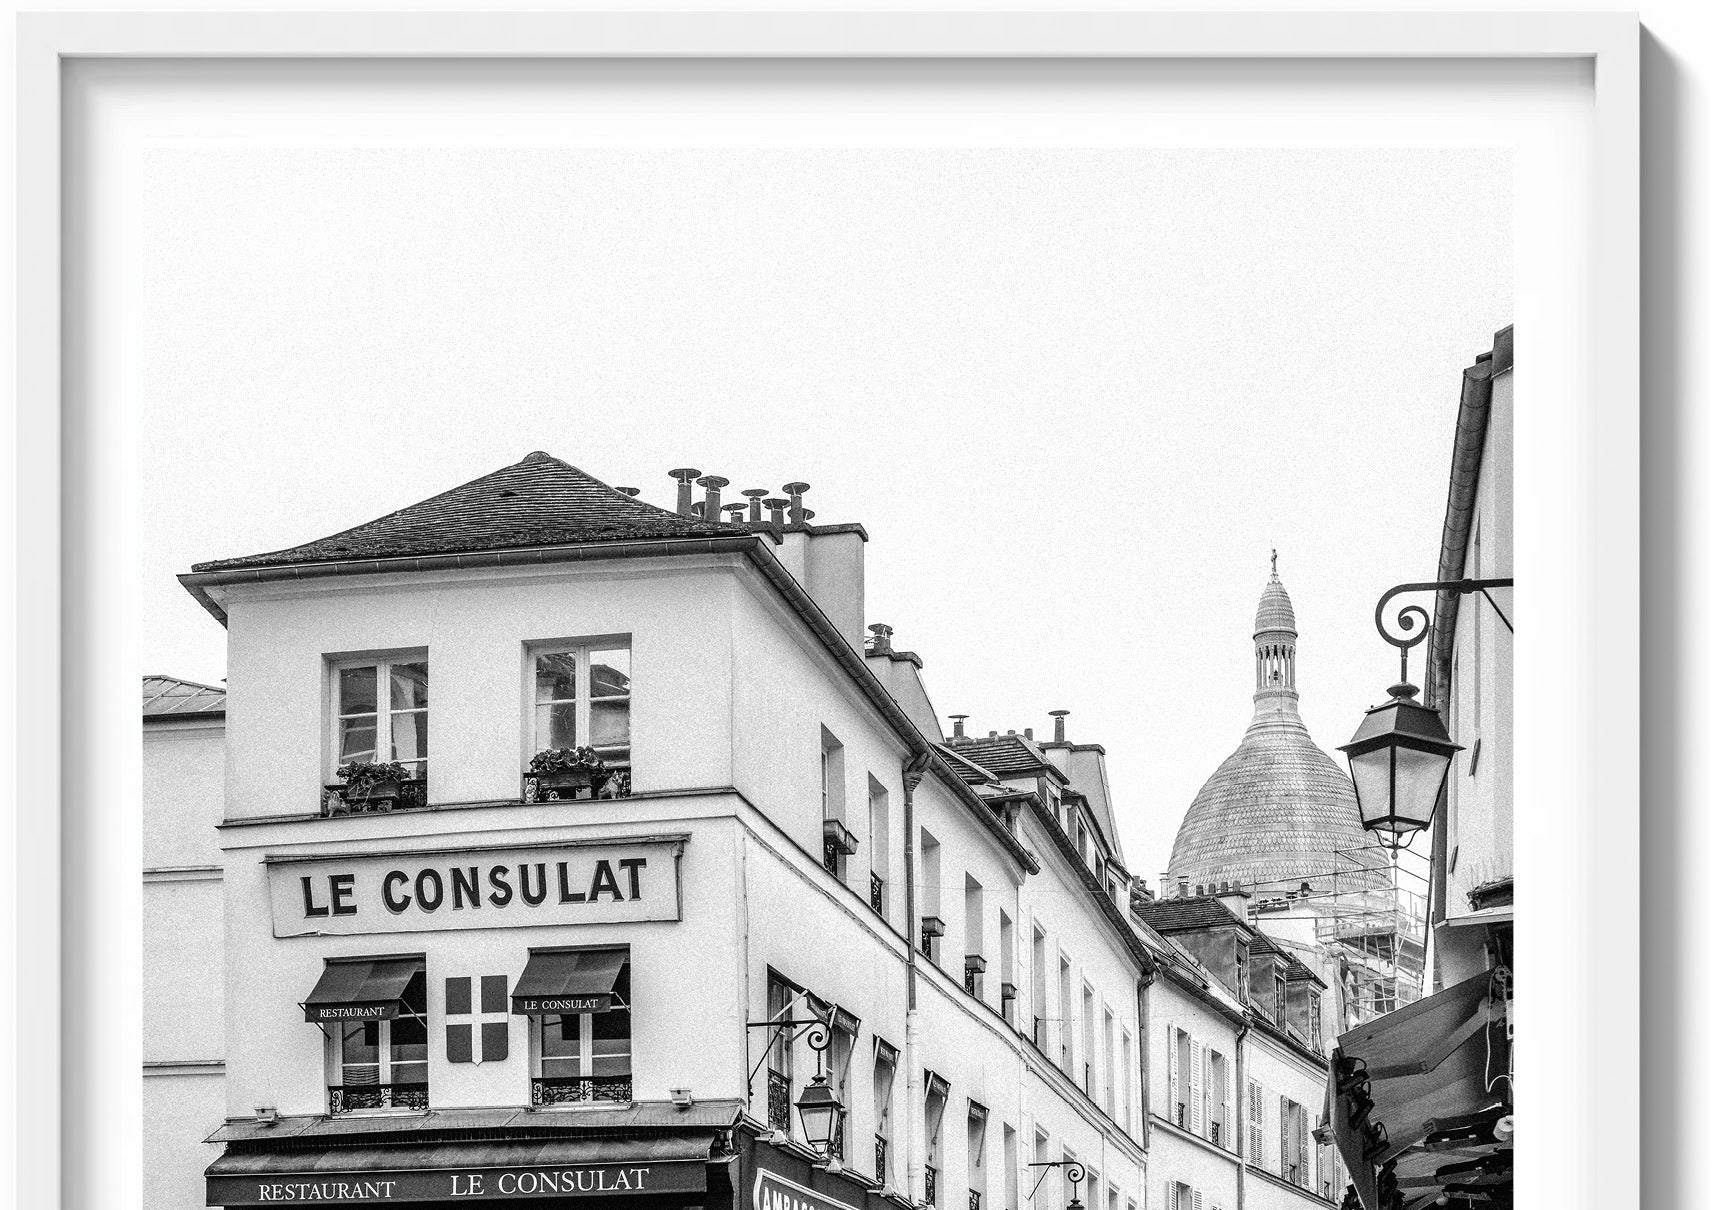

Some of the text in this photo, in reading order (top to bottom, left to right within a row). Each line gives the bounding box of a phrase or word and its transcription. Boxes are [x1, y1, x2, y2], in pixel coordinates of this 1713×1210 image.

[300, 858, 647, 918] LE CONSULAT
[320, 1006, 385, 1018] RESTAURANT
[524, 998, 599, 1010] LE CONSULAT
[258, 1168, 650, 1200] RESTAURANT LE CONSULAT
